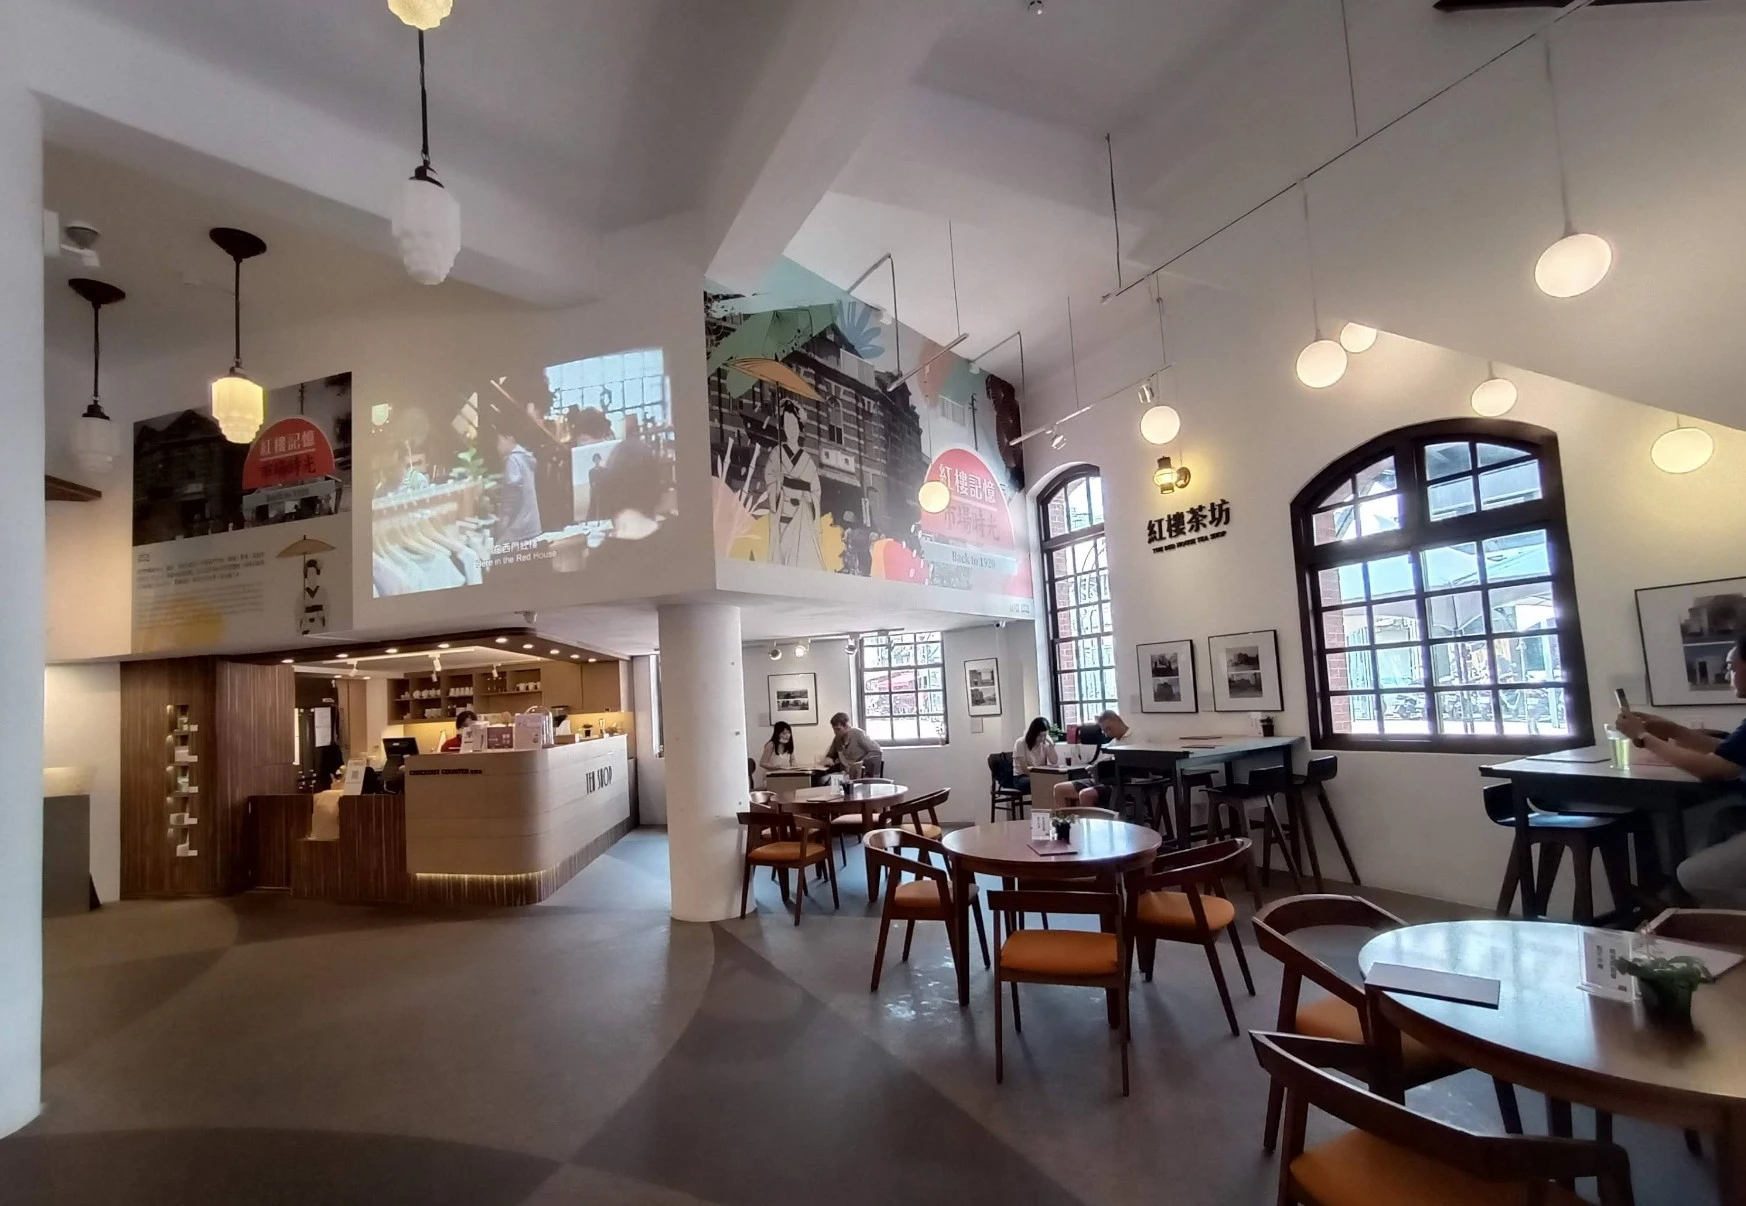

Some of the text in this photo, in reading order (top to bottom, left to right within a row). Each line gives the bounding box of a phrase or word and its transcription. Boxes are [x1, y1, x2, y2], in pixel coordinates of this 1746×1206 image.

[260, 430, 315, 456] 紅樓記憶
[939, 464, 996, 503] 紅樓記憶
[1147, 498, 1231, 544] 紅樓茶坊
[1176, 538, 1197, 548] HOUSE
[1209, 530, 1227, 540] SHOP
[503, 555, 514, 564] the
[516, 552, 531, 562] Red
[533, 550, 557, 560] House
[951, 550, 970, 565] Back
[971, 555, 978, 566] to
